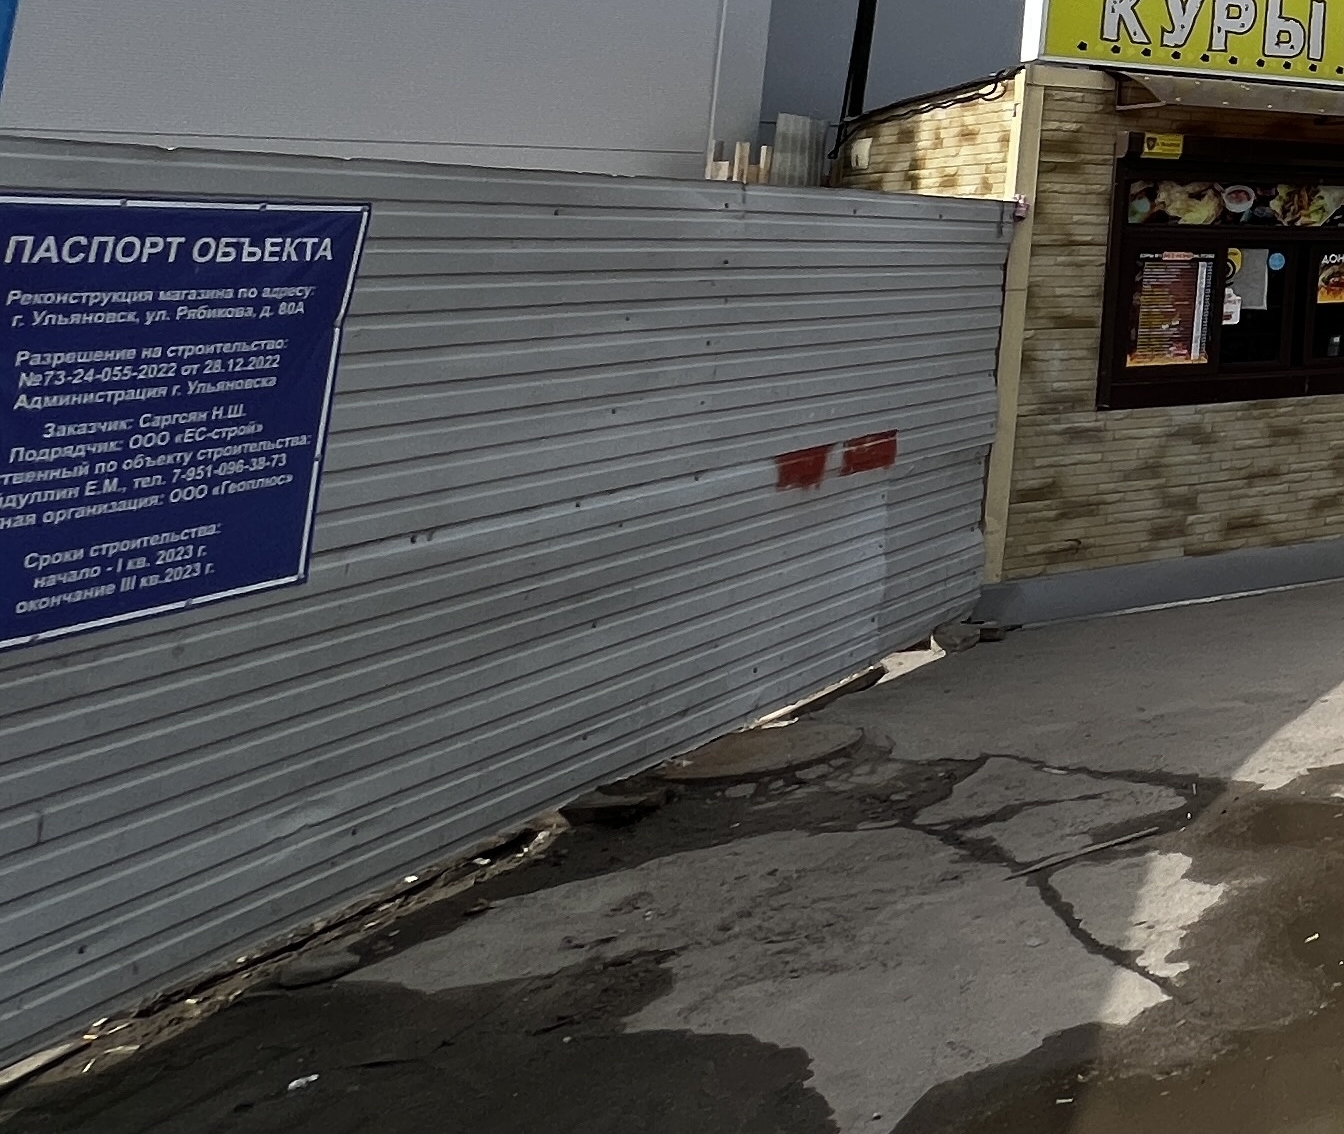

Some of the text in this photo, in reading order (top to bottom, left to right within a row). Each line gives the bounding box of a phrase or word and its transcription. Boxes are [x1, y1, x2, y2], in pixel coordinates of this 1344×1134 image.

[4, 235, 334, 265] ПАСПОРТ ОБЪЕКТА
[6, 290, 153, 306] Реконструкция
[158, 288, 234, 301] магазина
[238, 287, 258, 298] по
[11, 314, 25, 327] г.
[32, 309, 140, 326] Ульяновск,
[144, 310, 170, 325] ул.
[15, 339, 289, 368] Разрешение на строительство:
[18, 354, 280, 389] №73-24-055-2022 от 28.12.2022
[13, 385, 168, 410] Администрация
[187, 376, 277, 396] Ульяновска
[43, 418, 134, 438] Заказчик:
[9, 440, 124, 463] Подрядчик:
[129, 431, 170, 449] ООО
[94, 460, 118, 475] по
[122, 451, 193, 470] объекту
[133, 474, 166, 489] тел.
[42, 494, 165, 525] организация:
[169, 485, 208, 503] ООО
[24, 523, 223, 570] Сроки строительства:
[33, 566, 101, 589] начало
[155, 544, 193, 565] 2023
[15, 582, 116, 614] окончание
